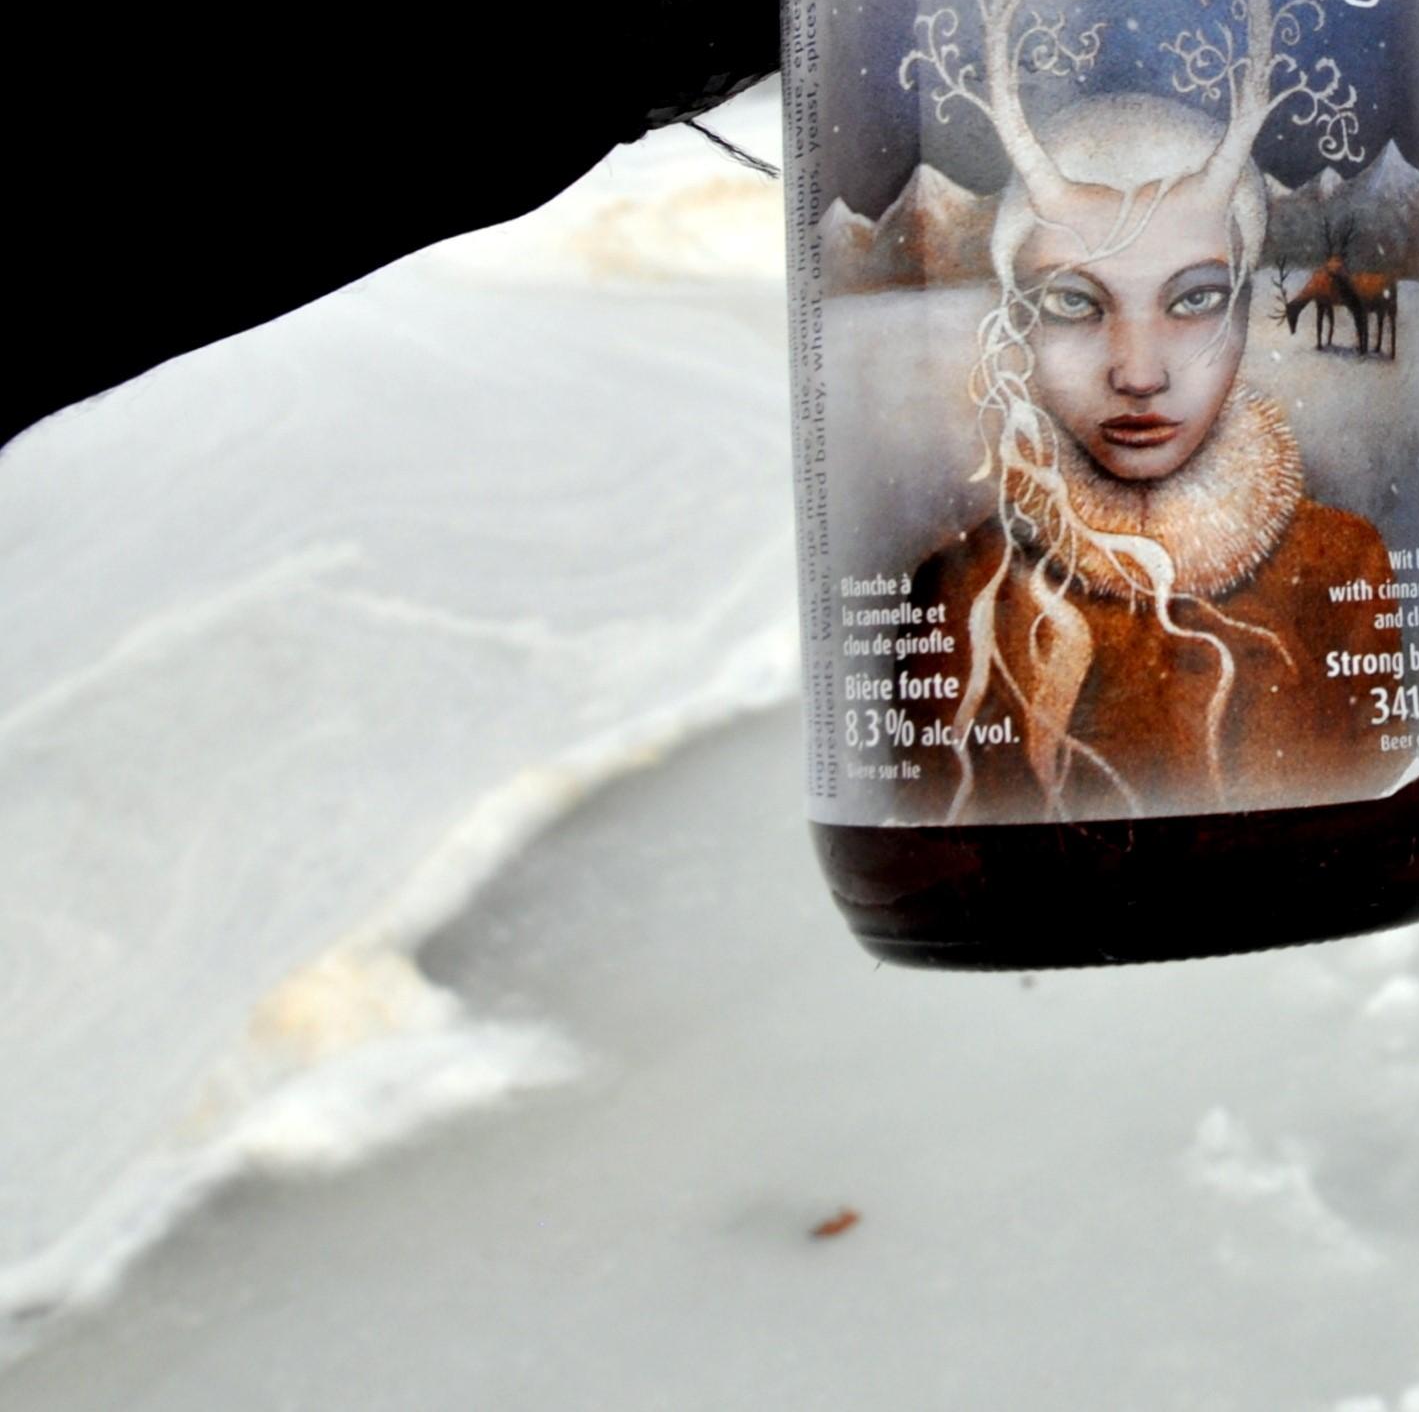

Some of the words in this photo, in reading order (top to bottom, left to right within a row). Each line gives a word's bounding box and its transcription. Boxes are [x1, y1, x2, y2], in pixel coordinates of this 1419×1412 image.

[1388, 548, 1412, 570] Wit
[841, 573, 896, 597] Blanche
[901, 572, 912, 595] à
[1329, 578, 1372, 603] with
[842, 605, 854, 626] la
[856, 603, 923, 625] cannelle
[926, 603, 946, 624] et
[1374, 606, 1403, 629] and
[843, 635, 869, 656] clou
[873, 633, 891, 655] de
[895, 627, 955, 660] girofle
[1326, 650, 1404, 680] Strong
[845, 672, 892, 700] Bière
[899, 671, 959, 700] forte
[1381, 733, 1412, 752] Beer
[879, 764, 899, 779] sur
[902, 760, 920, 779] lie
